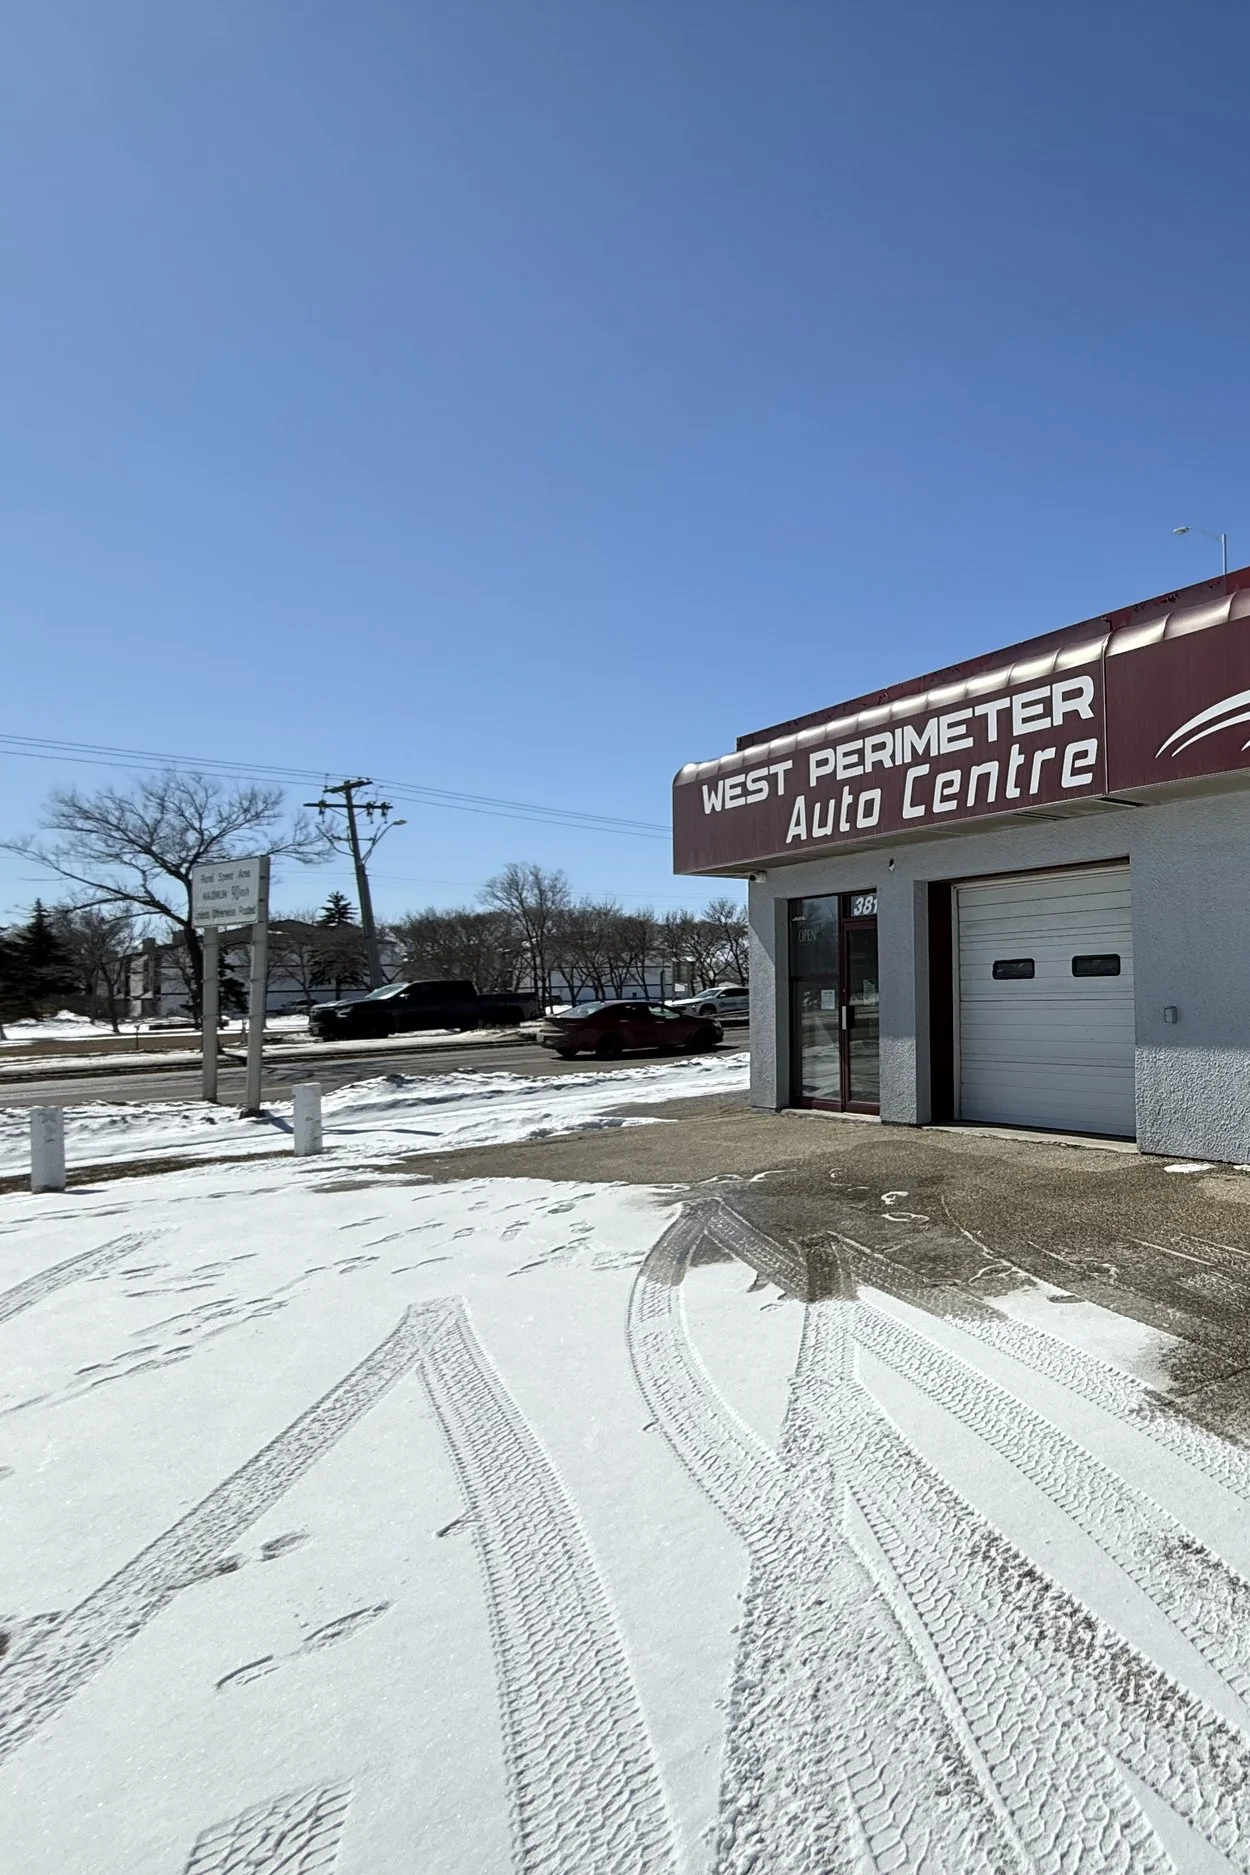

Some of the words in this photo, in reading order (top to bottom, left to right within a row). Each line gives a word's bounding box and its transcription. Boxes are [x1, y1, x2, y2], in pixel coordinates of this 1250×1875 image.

[702, 760, 793, 815] WEST
[809, 675, 1095, 787] PERIMETER
[785, 785, 882, 844] Auto
[902, 738, 1098, 819] Centre
[798, 928, 817, 943] OPEN
